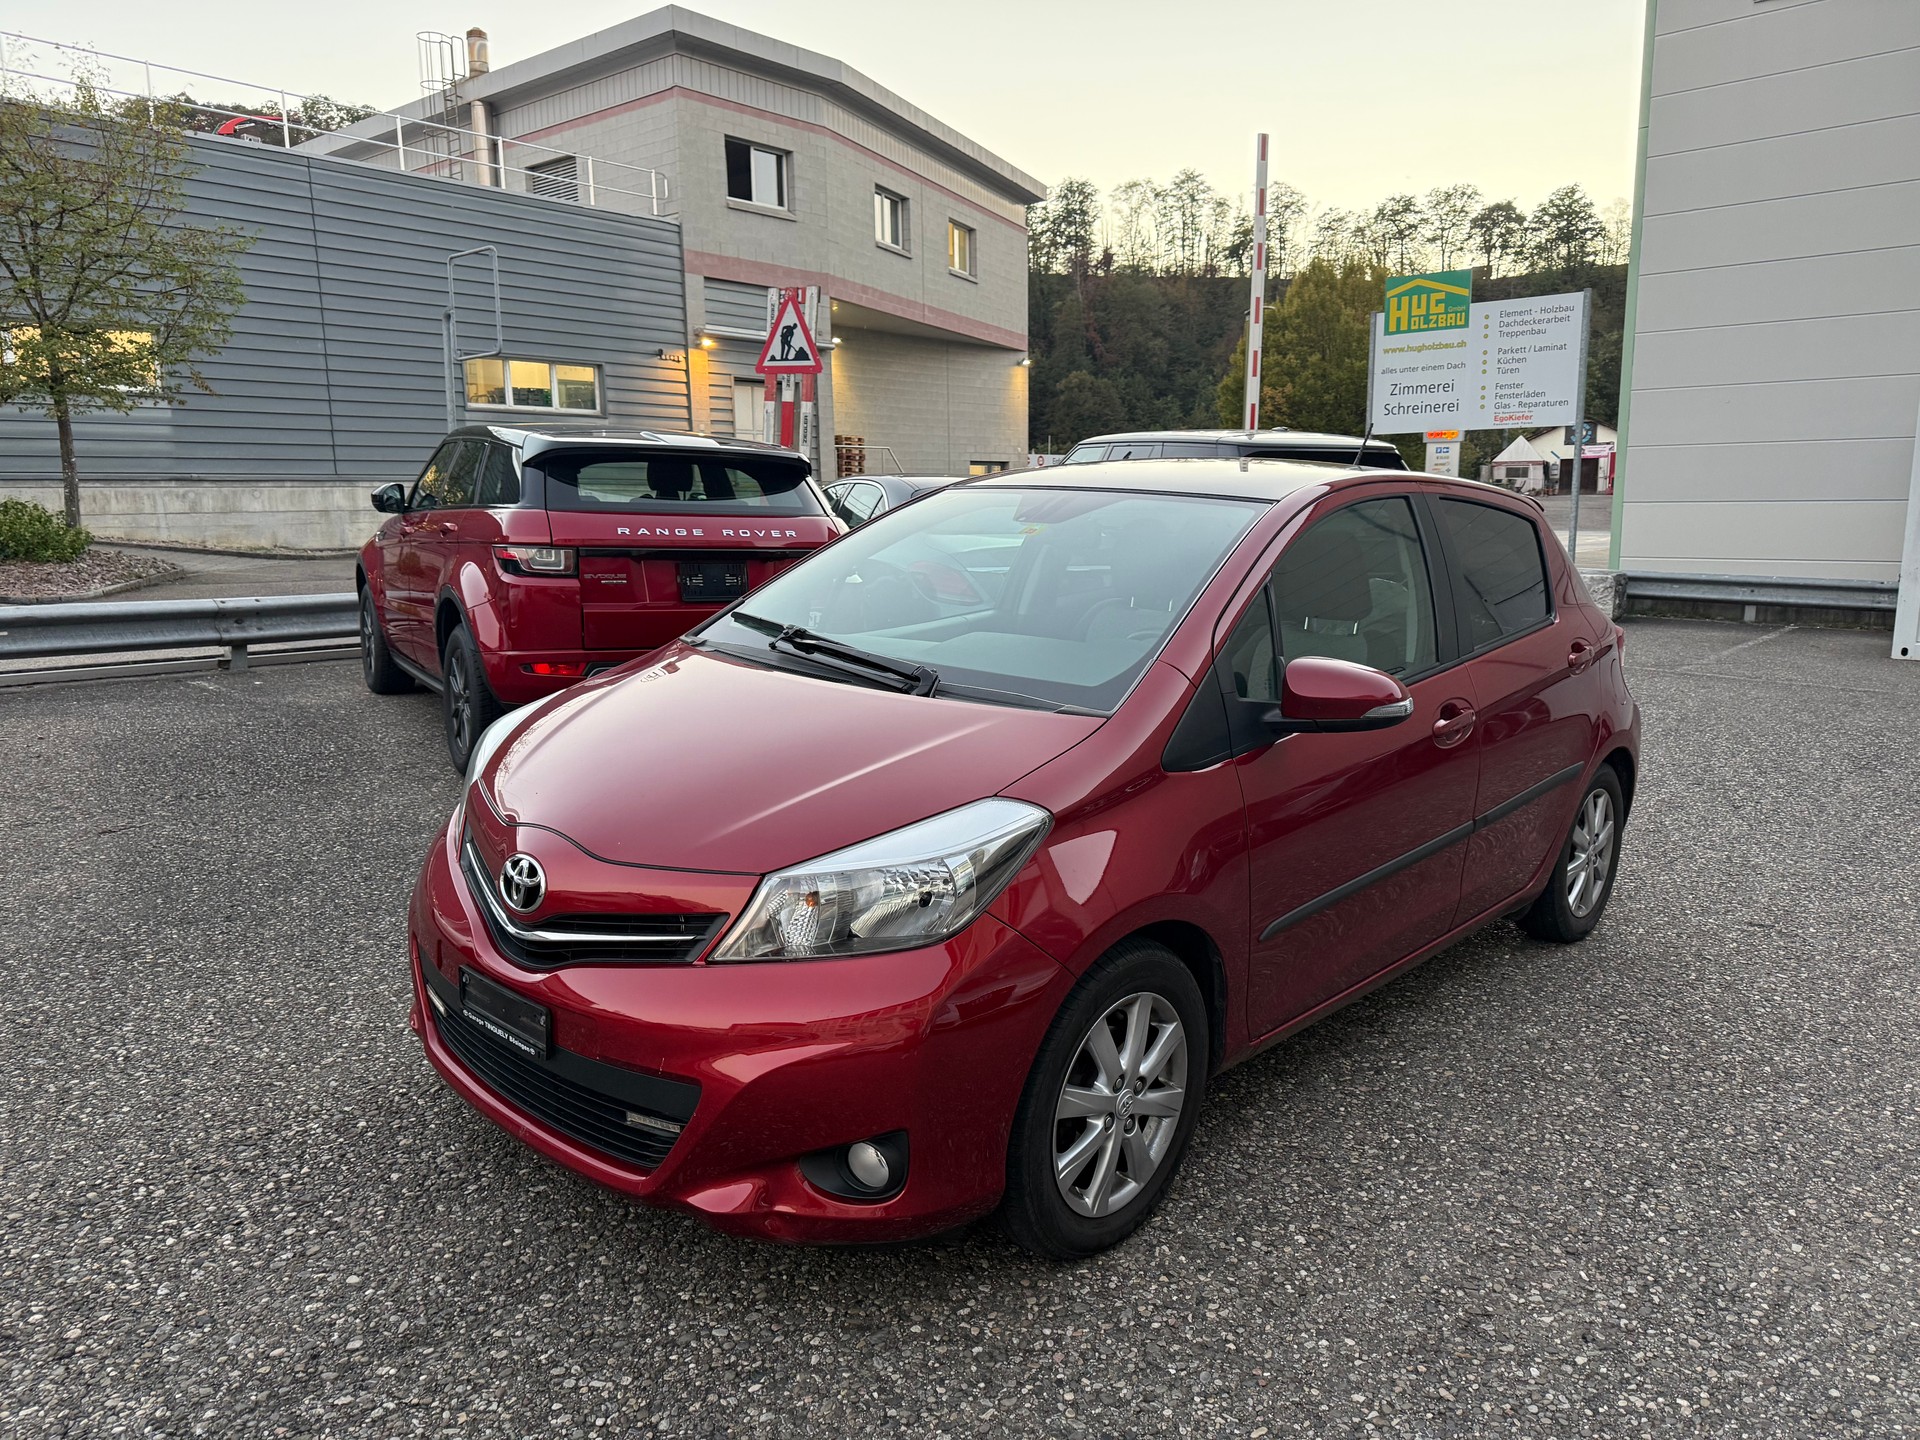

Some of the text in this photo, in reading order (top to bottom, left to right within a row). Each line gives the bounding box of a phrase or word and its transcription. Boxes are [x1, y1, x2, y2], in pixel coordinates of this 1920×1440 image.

[1499, 308, 1533, 319] Element
[1540, 304, 1575, 315] Holzbau
[1498, 314, 1571, 329] Dachdeckerarbeit
[1498, 327, 1547, 339] Treppenbau
[1382, 339, 1467, 354] www.hugholzbau.ch
[1497, 346, 1527, 356] Parkett
[1533, 343, 1567, 353] Laminat
[1497, 356, 1527, 366] Küchen
[1380, 361, 1466, 375] alles unter einem Dach
[1496, 366, 1520, 375] Türen
[1389, 379, 1455, 397] Zimmerei
[1495, 382, 1525, 391] Fenster
[1494, 390, 1546, 400] Fensterläden
[1383, 398, 1460, 416] Schreinerei
[1494, 401, 1511, 410] Glas
[1517, 399, 1569, 410] Reparaturen
[1493, 413, 1534, 423] EgoKiefer
[616, 527, 798, 538] RANGE ROVER
[468, 1012, 485, 1026] Garage
[484, 1020, 509, 1040] TINGUELY
